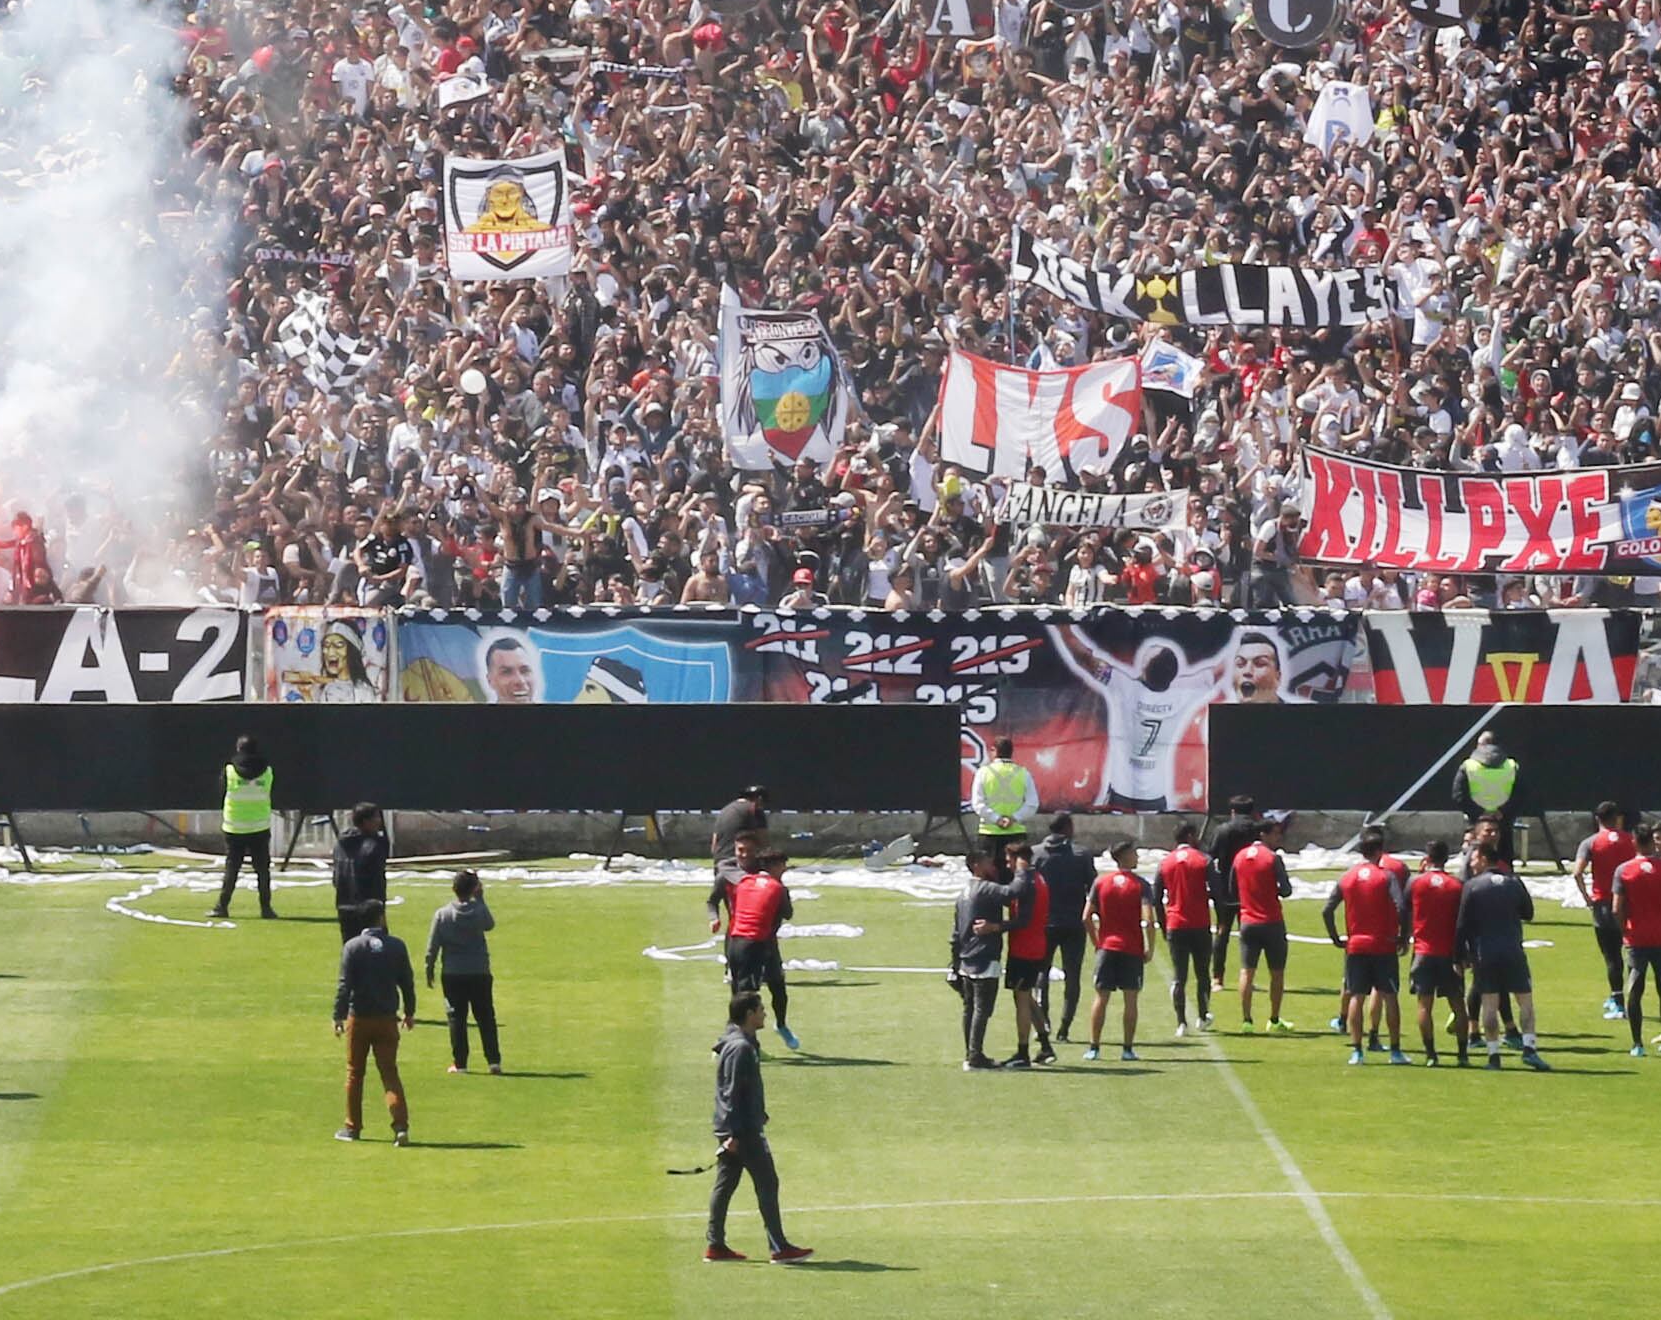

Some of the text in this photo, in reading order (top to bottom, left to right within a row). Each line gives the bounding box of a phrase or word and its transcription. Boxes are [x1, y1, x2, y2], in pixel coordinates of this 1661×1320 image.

[843, 630, 923, 675] 212
[950, 634, 1031, 675] 213
[1141, 719, 1163, 757] 7
